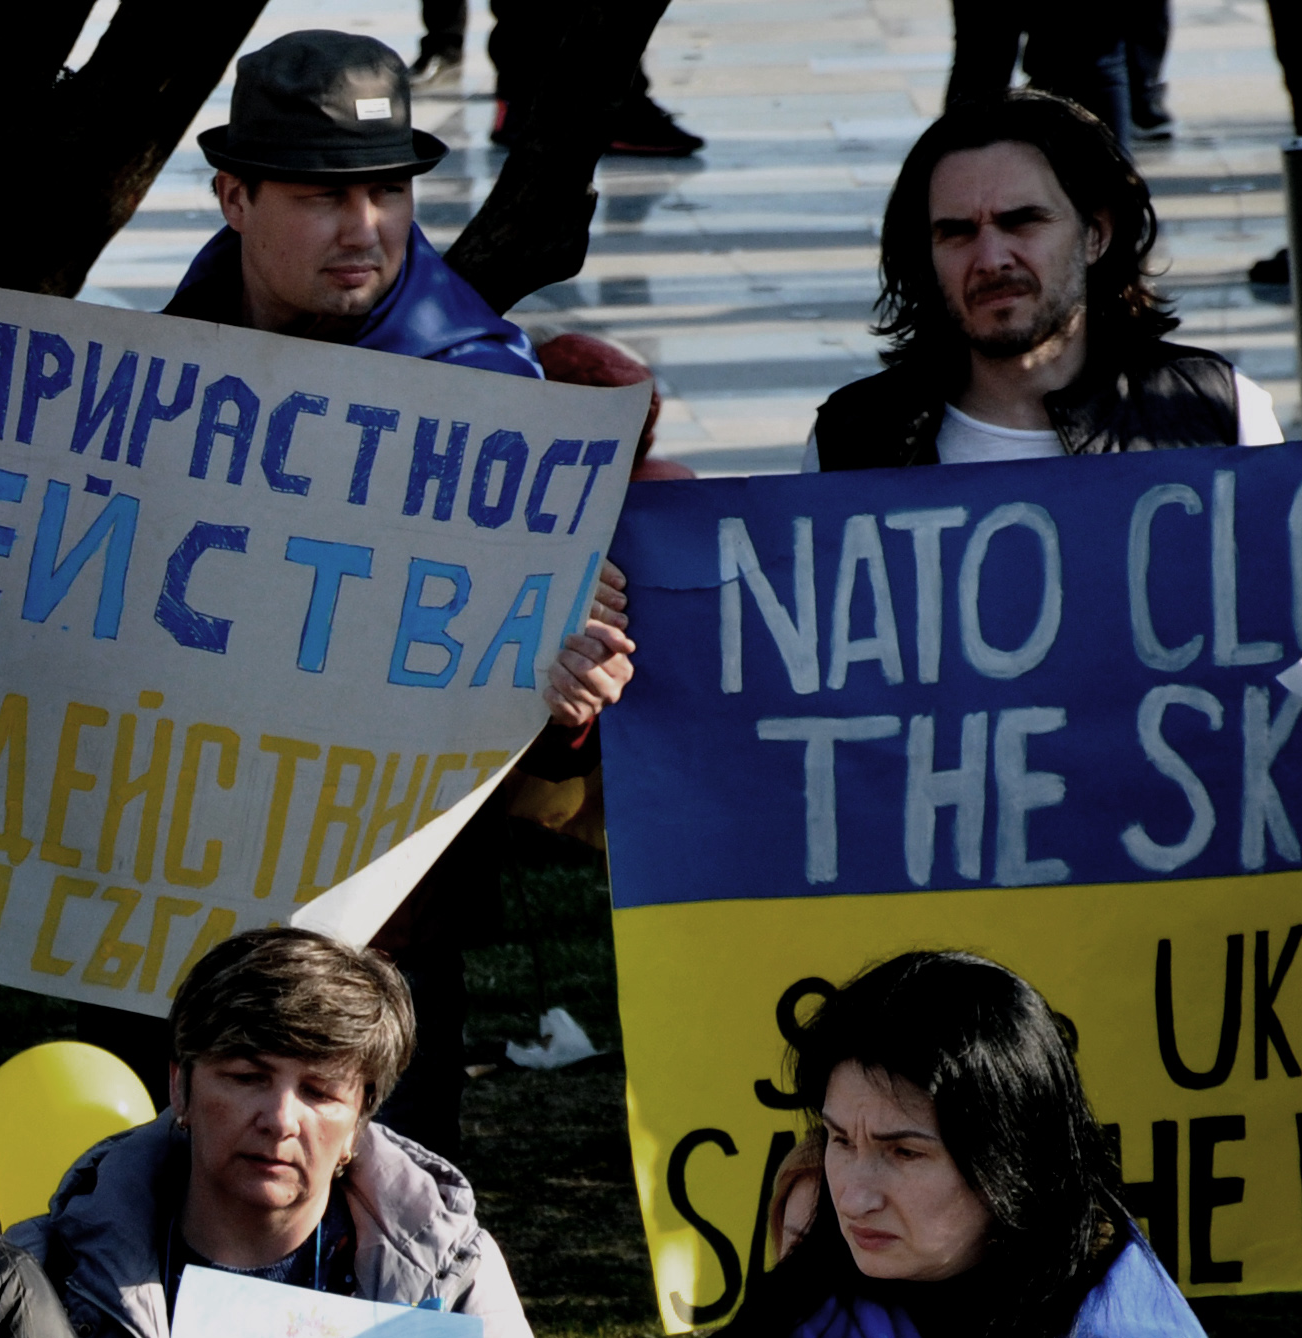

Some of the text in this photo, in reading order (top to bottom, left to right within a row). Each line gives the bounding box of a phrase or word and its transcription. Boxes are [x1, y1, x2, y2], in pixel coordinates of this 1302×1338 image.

[719, 470, 1302, 696] NATO CL
[757, 705, 1071, 888] THE
